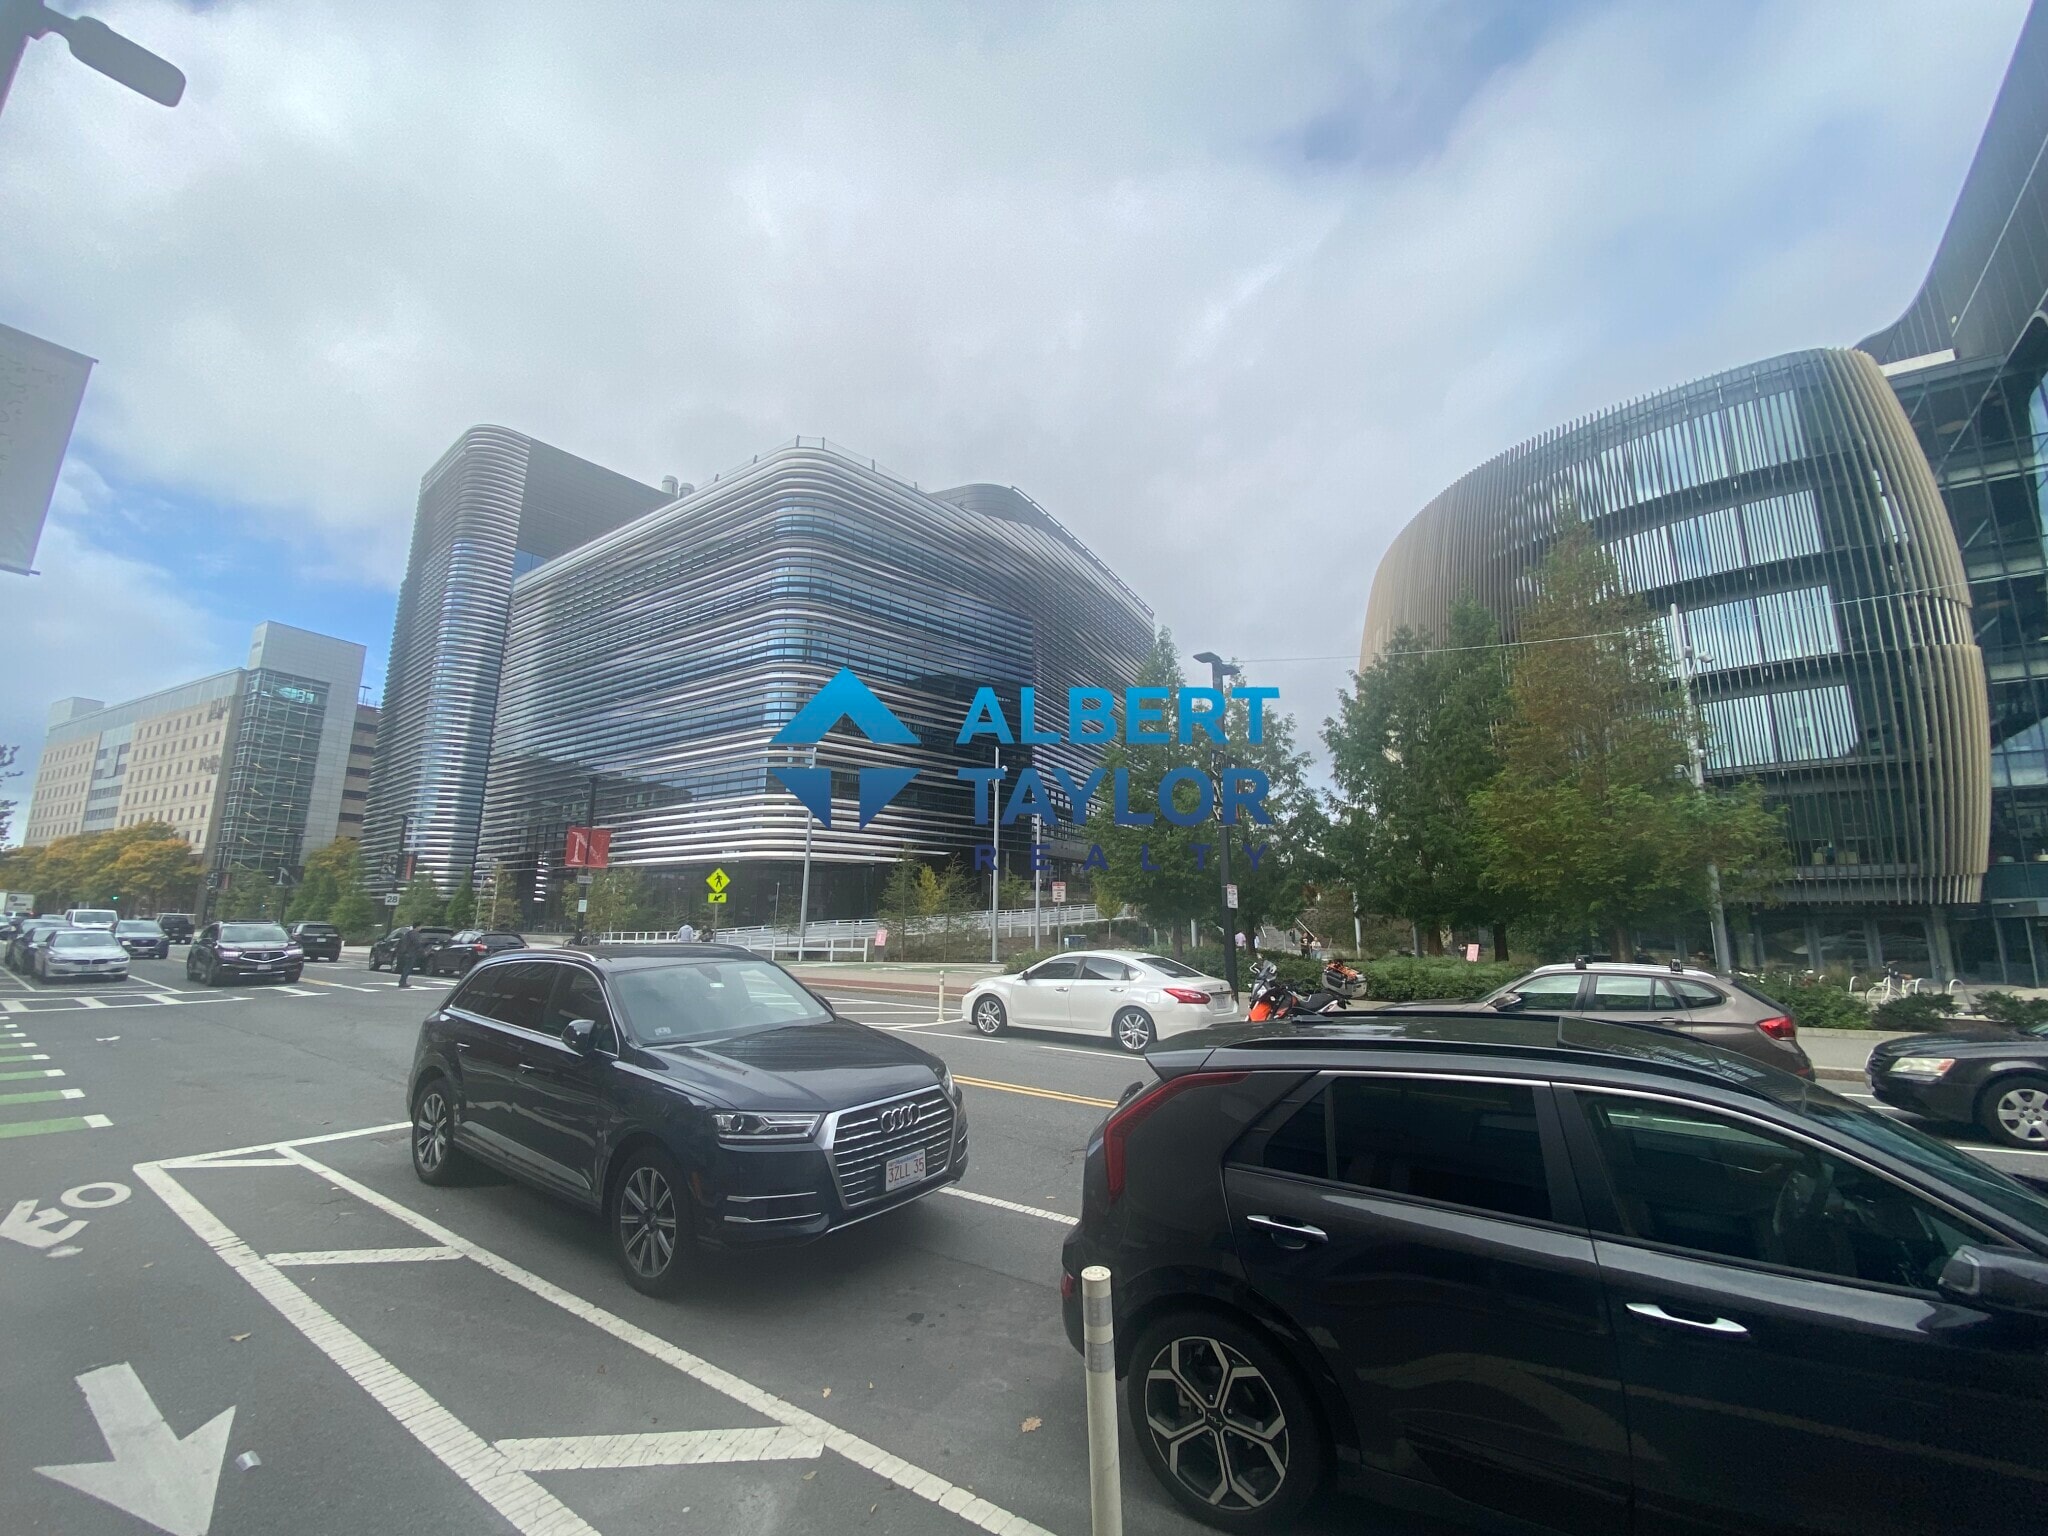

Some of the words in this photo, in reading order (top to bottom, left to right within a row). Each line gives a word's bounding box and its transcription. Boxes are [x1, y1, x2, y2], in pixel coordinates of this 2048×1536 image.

[386, 895, 398, 903] 28
[888, 1163, 910, 1182] 3ZLL
[914, 1158, 925, 1173] 35
